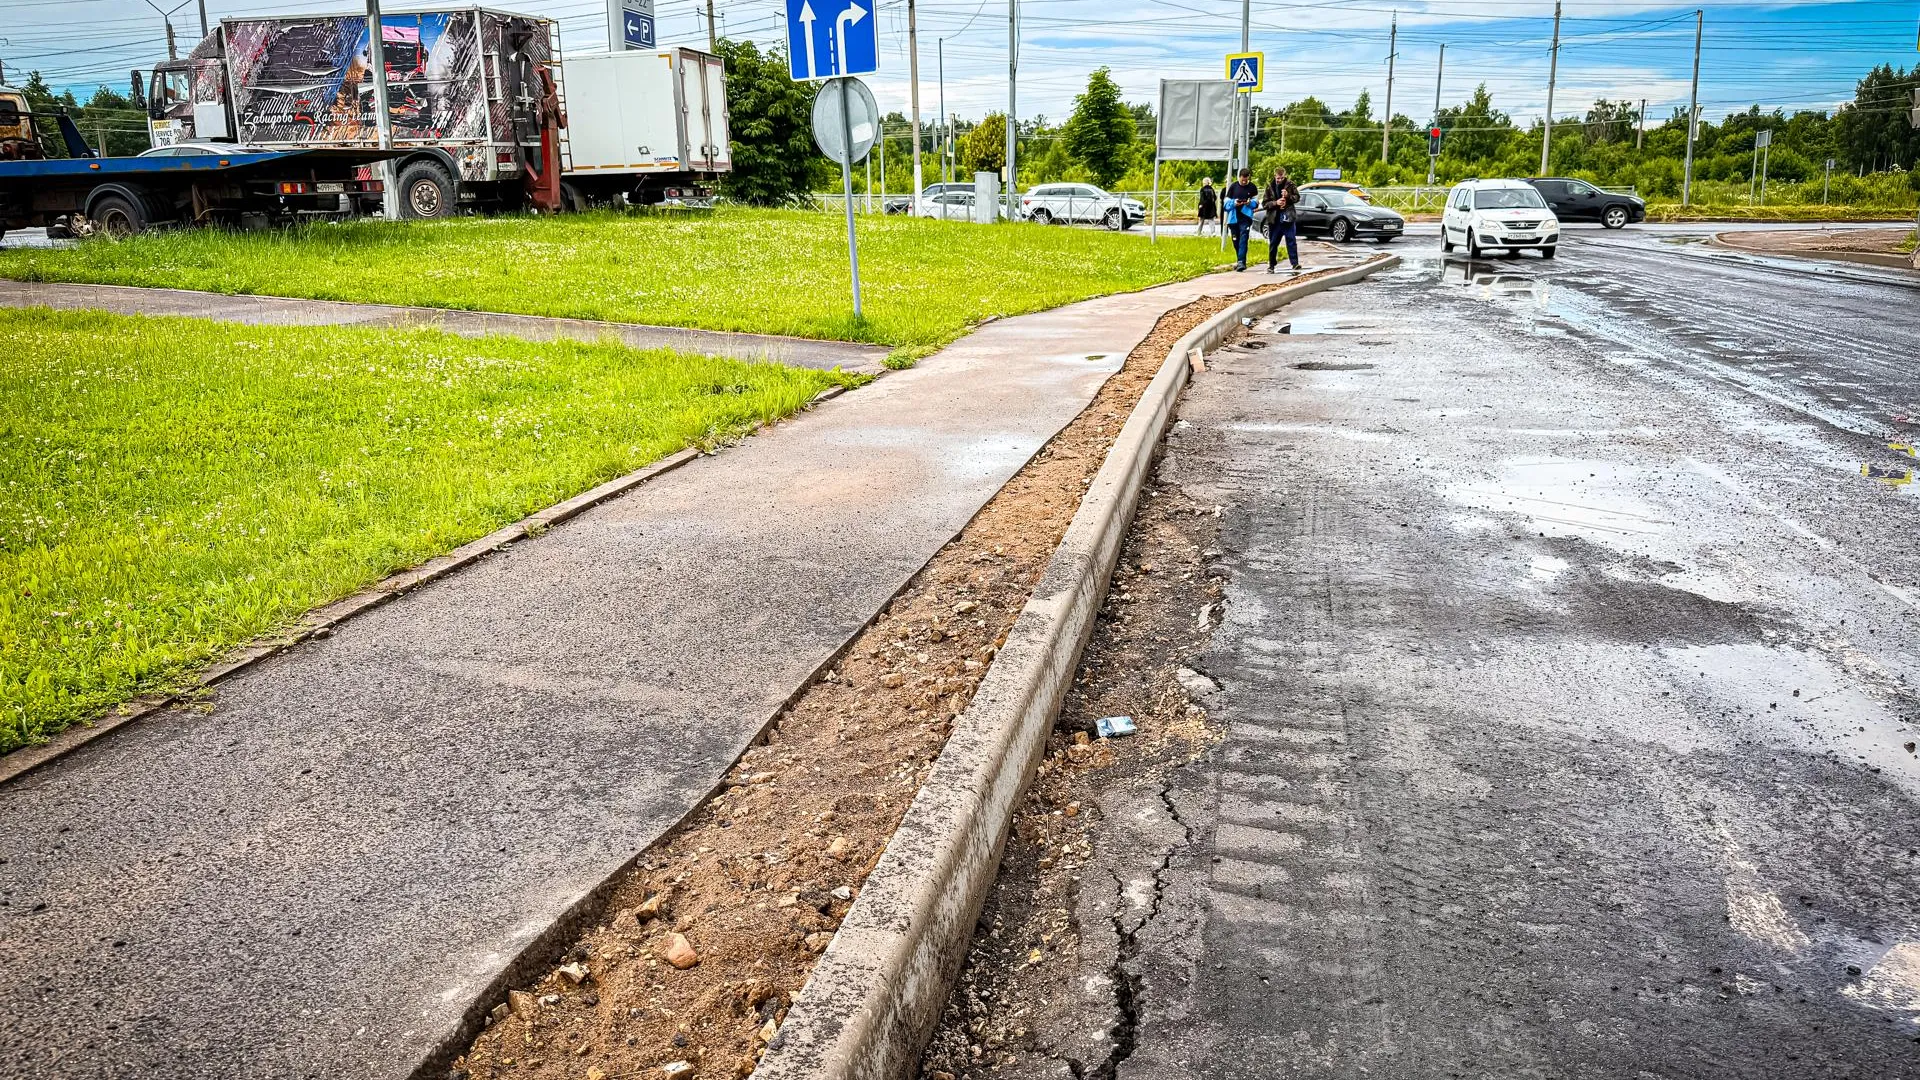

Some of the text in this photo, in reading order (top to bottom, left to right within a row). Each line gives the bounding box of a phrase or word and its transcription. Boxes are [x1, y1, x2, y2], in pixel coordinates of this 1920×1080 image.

[642, 22, 649, 39] P
[314, 111, 349, 125] Racing
[352, 111, 376, 121] team
[155, 130, 173, 138] SERVICE
